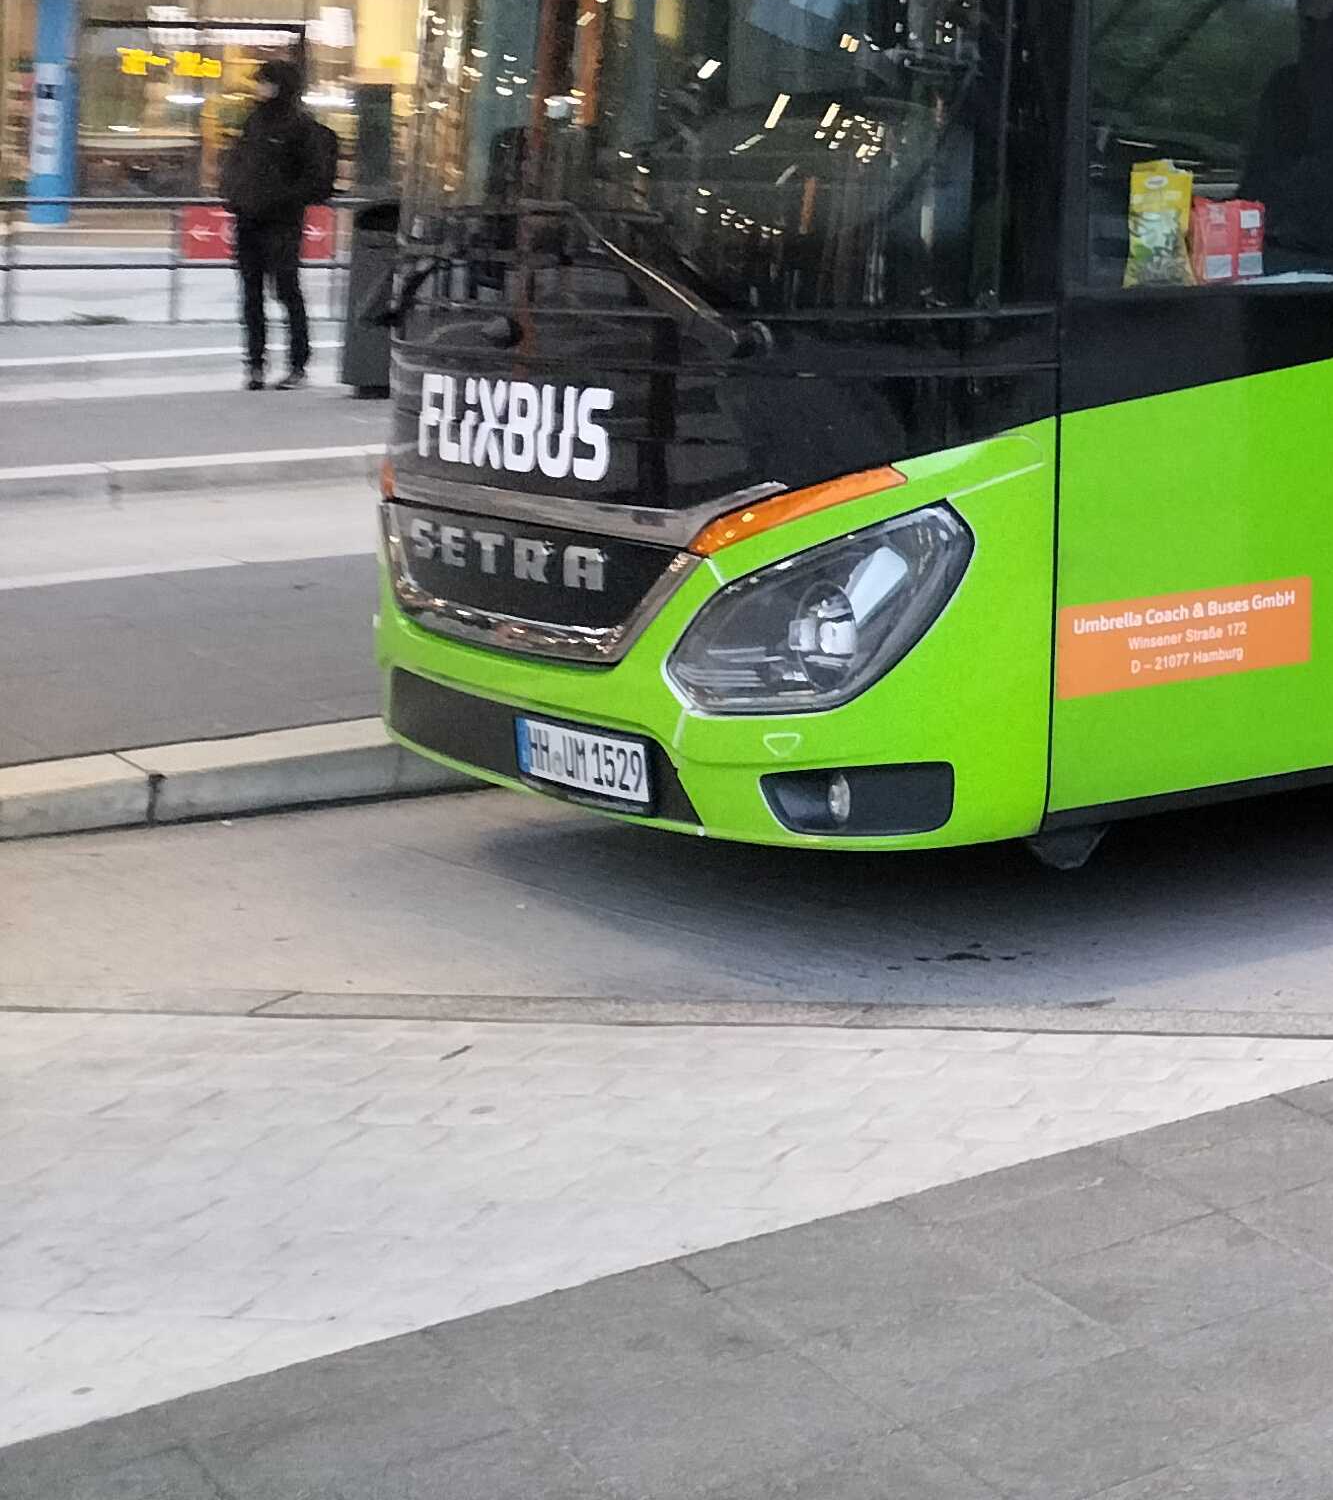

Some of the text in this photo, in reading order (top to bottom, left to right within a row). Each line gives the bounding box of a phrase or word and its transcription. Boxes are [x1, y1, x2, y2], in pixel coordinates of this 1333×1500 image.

[410, 518, 606, 592] SETRA
[1073, 590, 1296, 635] Umbrella Coach & Buses GmbH
[1128, 621, 1248, 650] Winsener Straße 172
[1130, 659, 1141, 674] D
[1154, 651, 1191, 671] 21077
[1192, 647, 1244, 664] Hamburg
[591, 742, 643, 793] 1529
